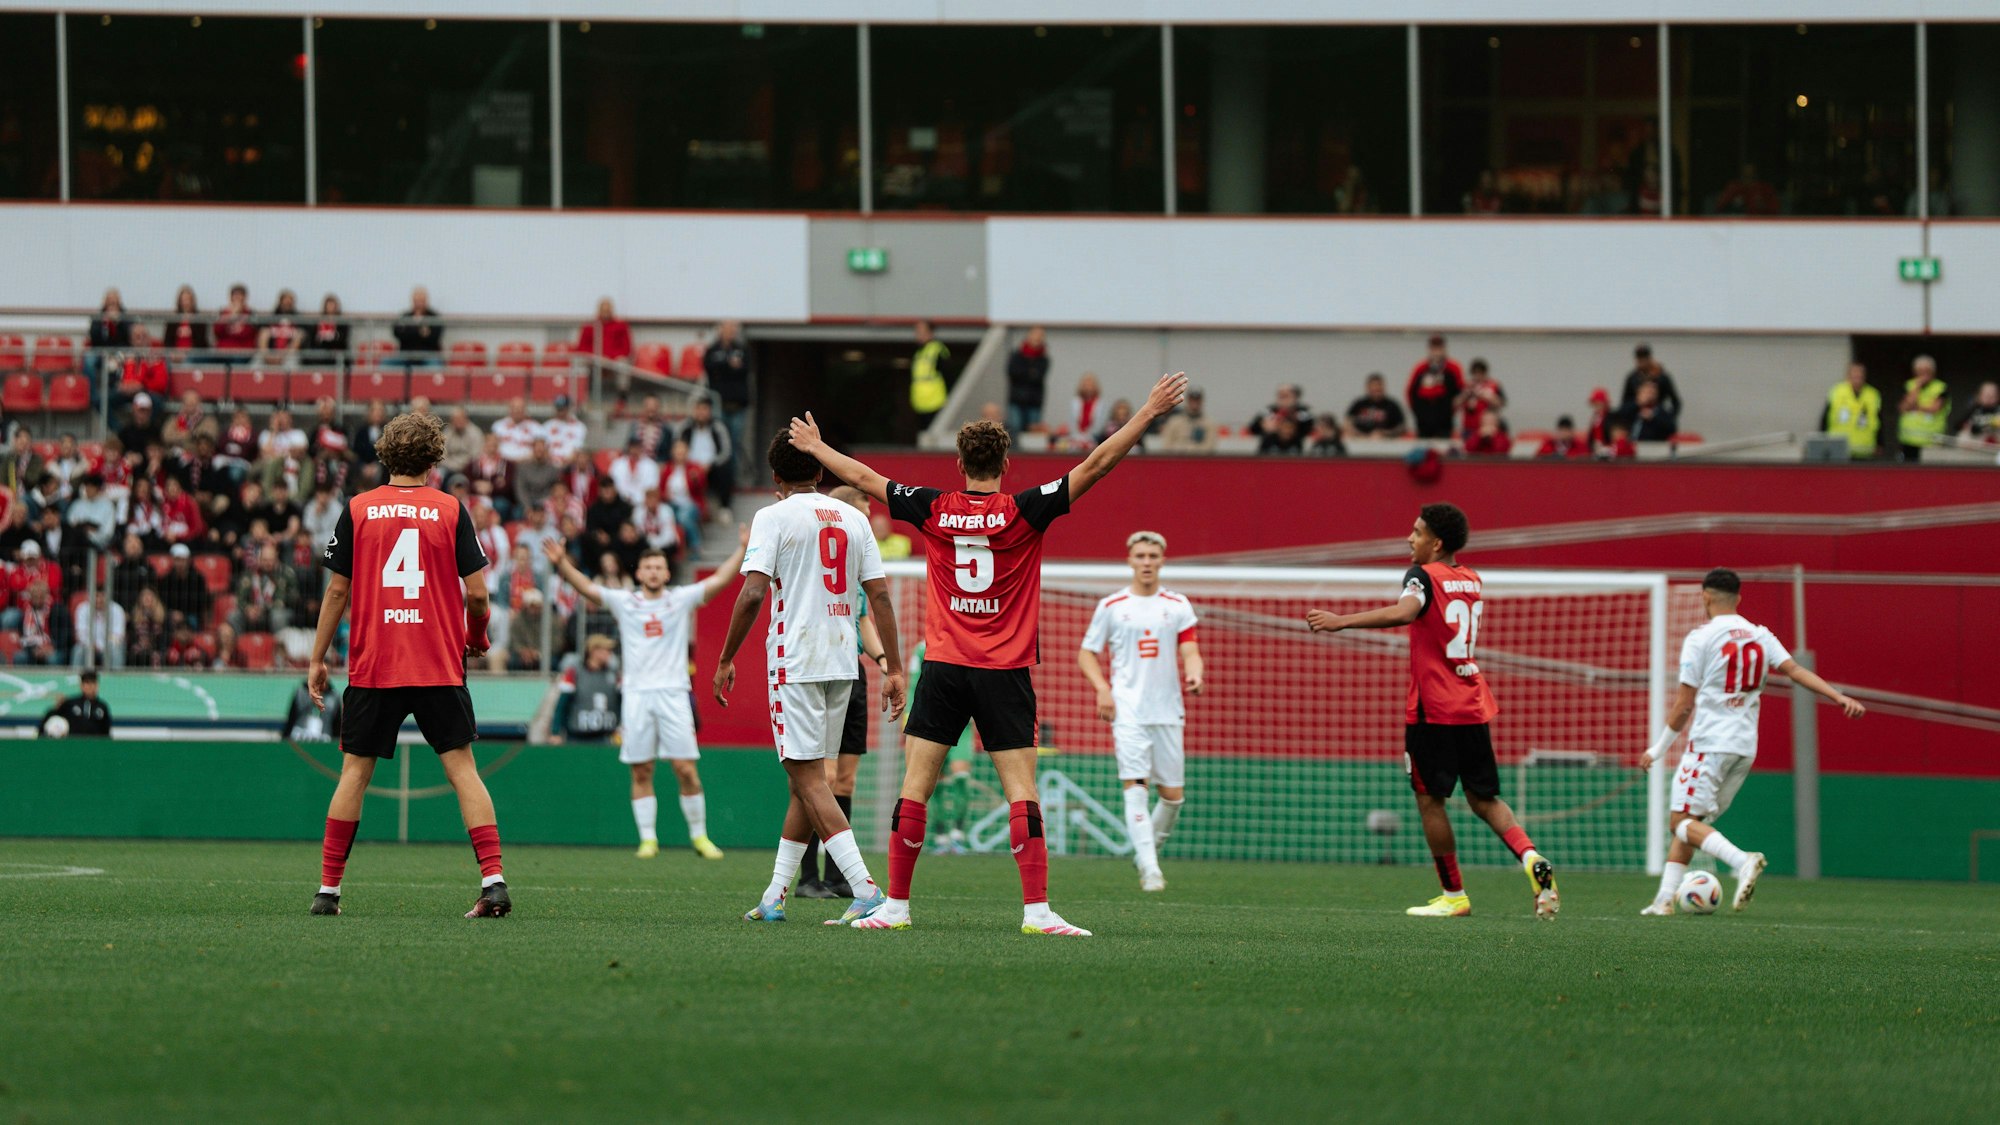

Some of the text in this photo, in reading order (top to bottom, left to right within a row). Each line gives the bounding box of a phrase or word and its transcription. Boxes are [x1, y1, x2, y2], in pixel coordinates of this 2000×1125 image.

[367, 504, 439, 522] BAYER 04
[815, 508, 842, 522] NIANG
[938, 513, 1006, 529] BAYER 04
[382, 528, 425, 600] 4
[818, 526, 848, 595] 9
[953, 535, 994, 593] 5
[950, 596, 999, 613] NATALI
[384, 609, 423, 624] POHL
[1721, 641, 1764, 693] 10
